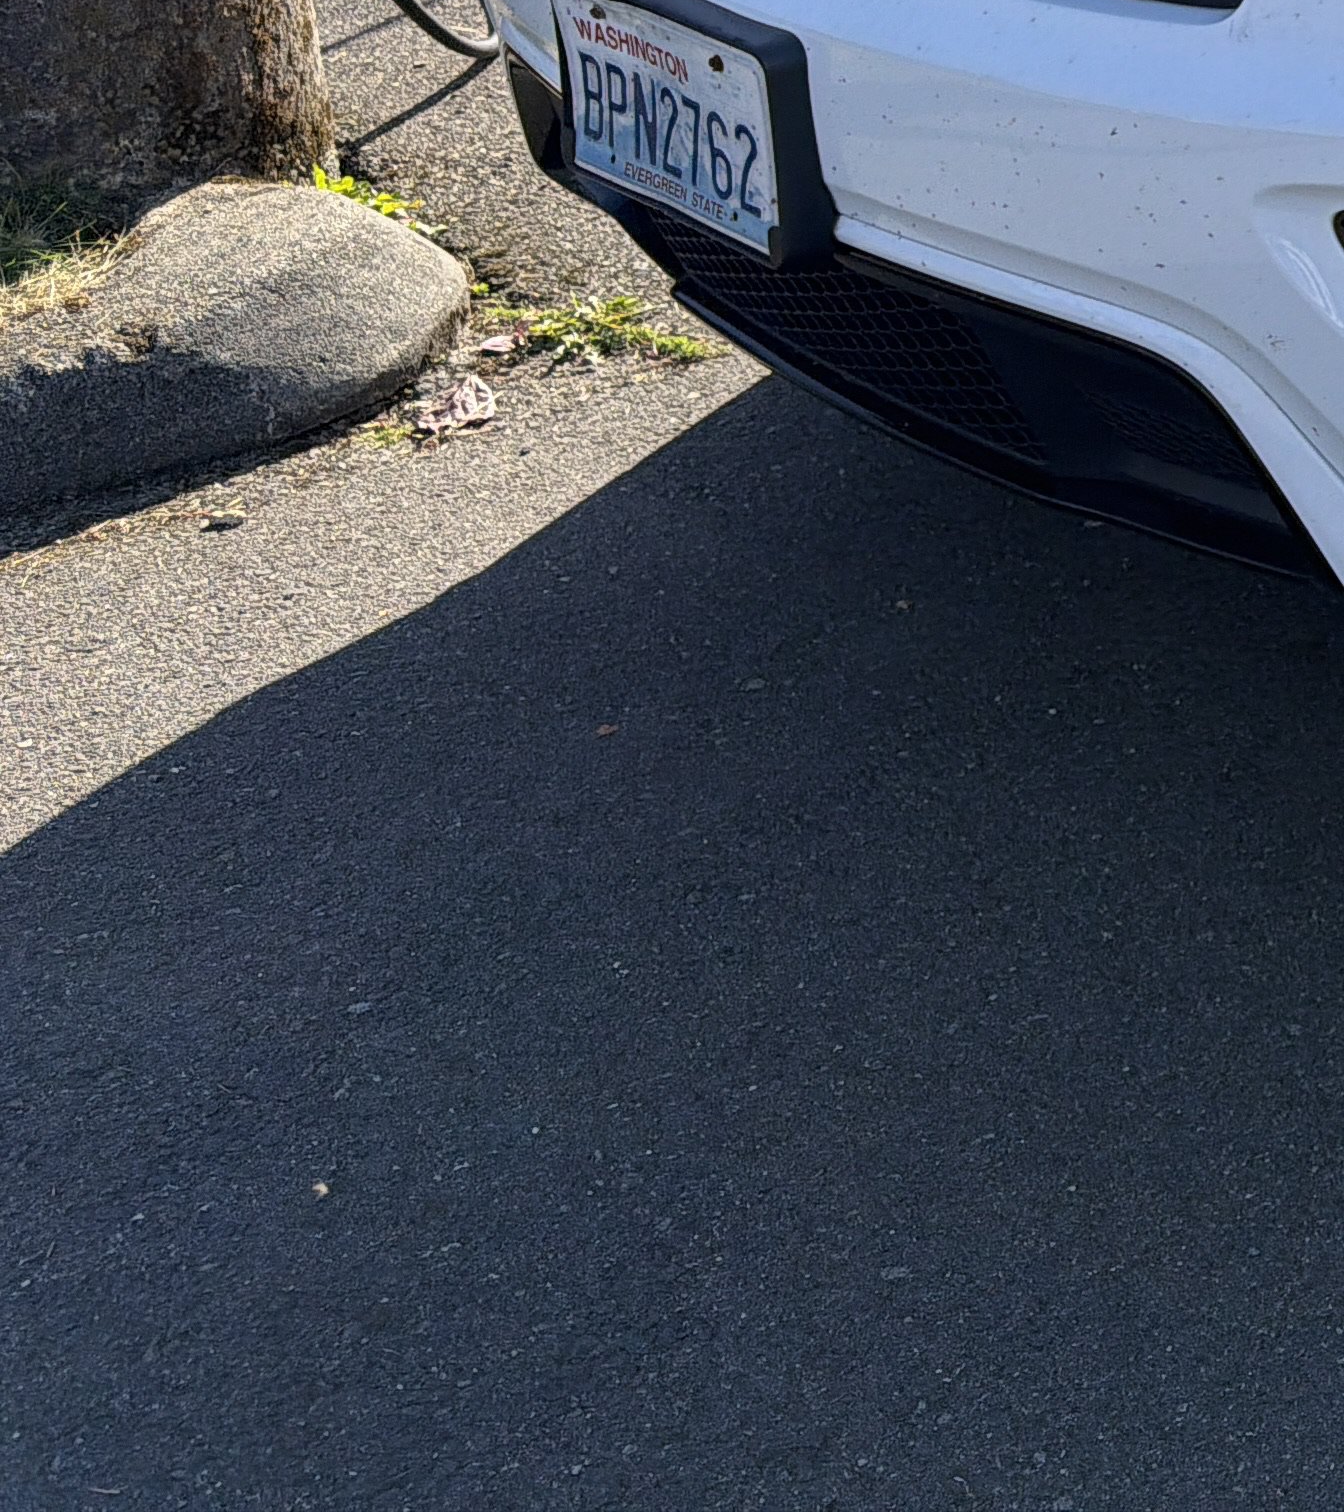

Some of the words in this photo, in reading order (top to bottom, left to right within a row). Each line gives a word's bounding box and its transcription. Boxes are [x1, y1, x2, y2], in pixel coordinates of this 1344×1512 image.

[573, 16, 689, 84] WASHINGTON
[578, 51, 763, 219] BPN2762
[623, 161, 688, 202] EVERGREEN
[691, 192, 726, 220] STATE
